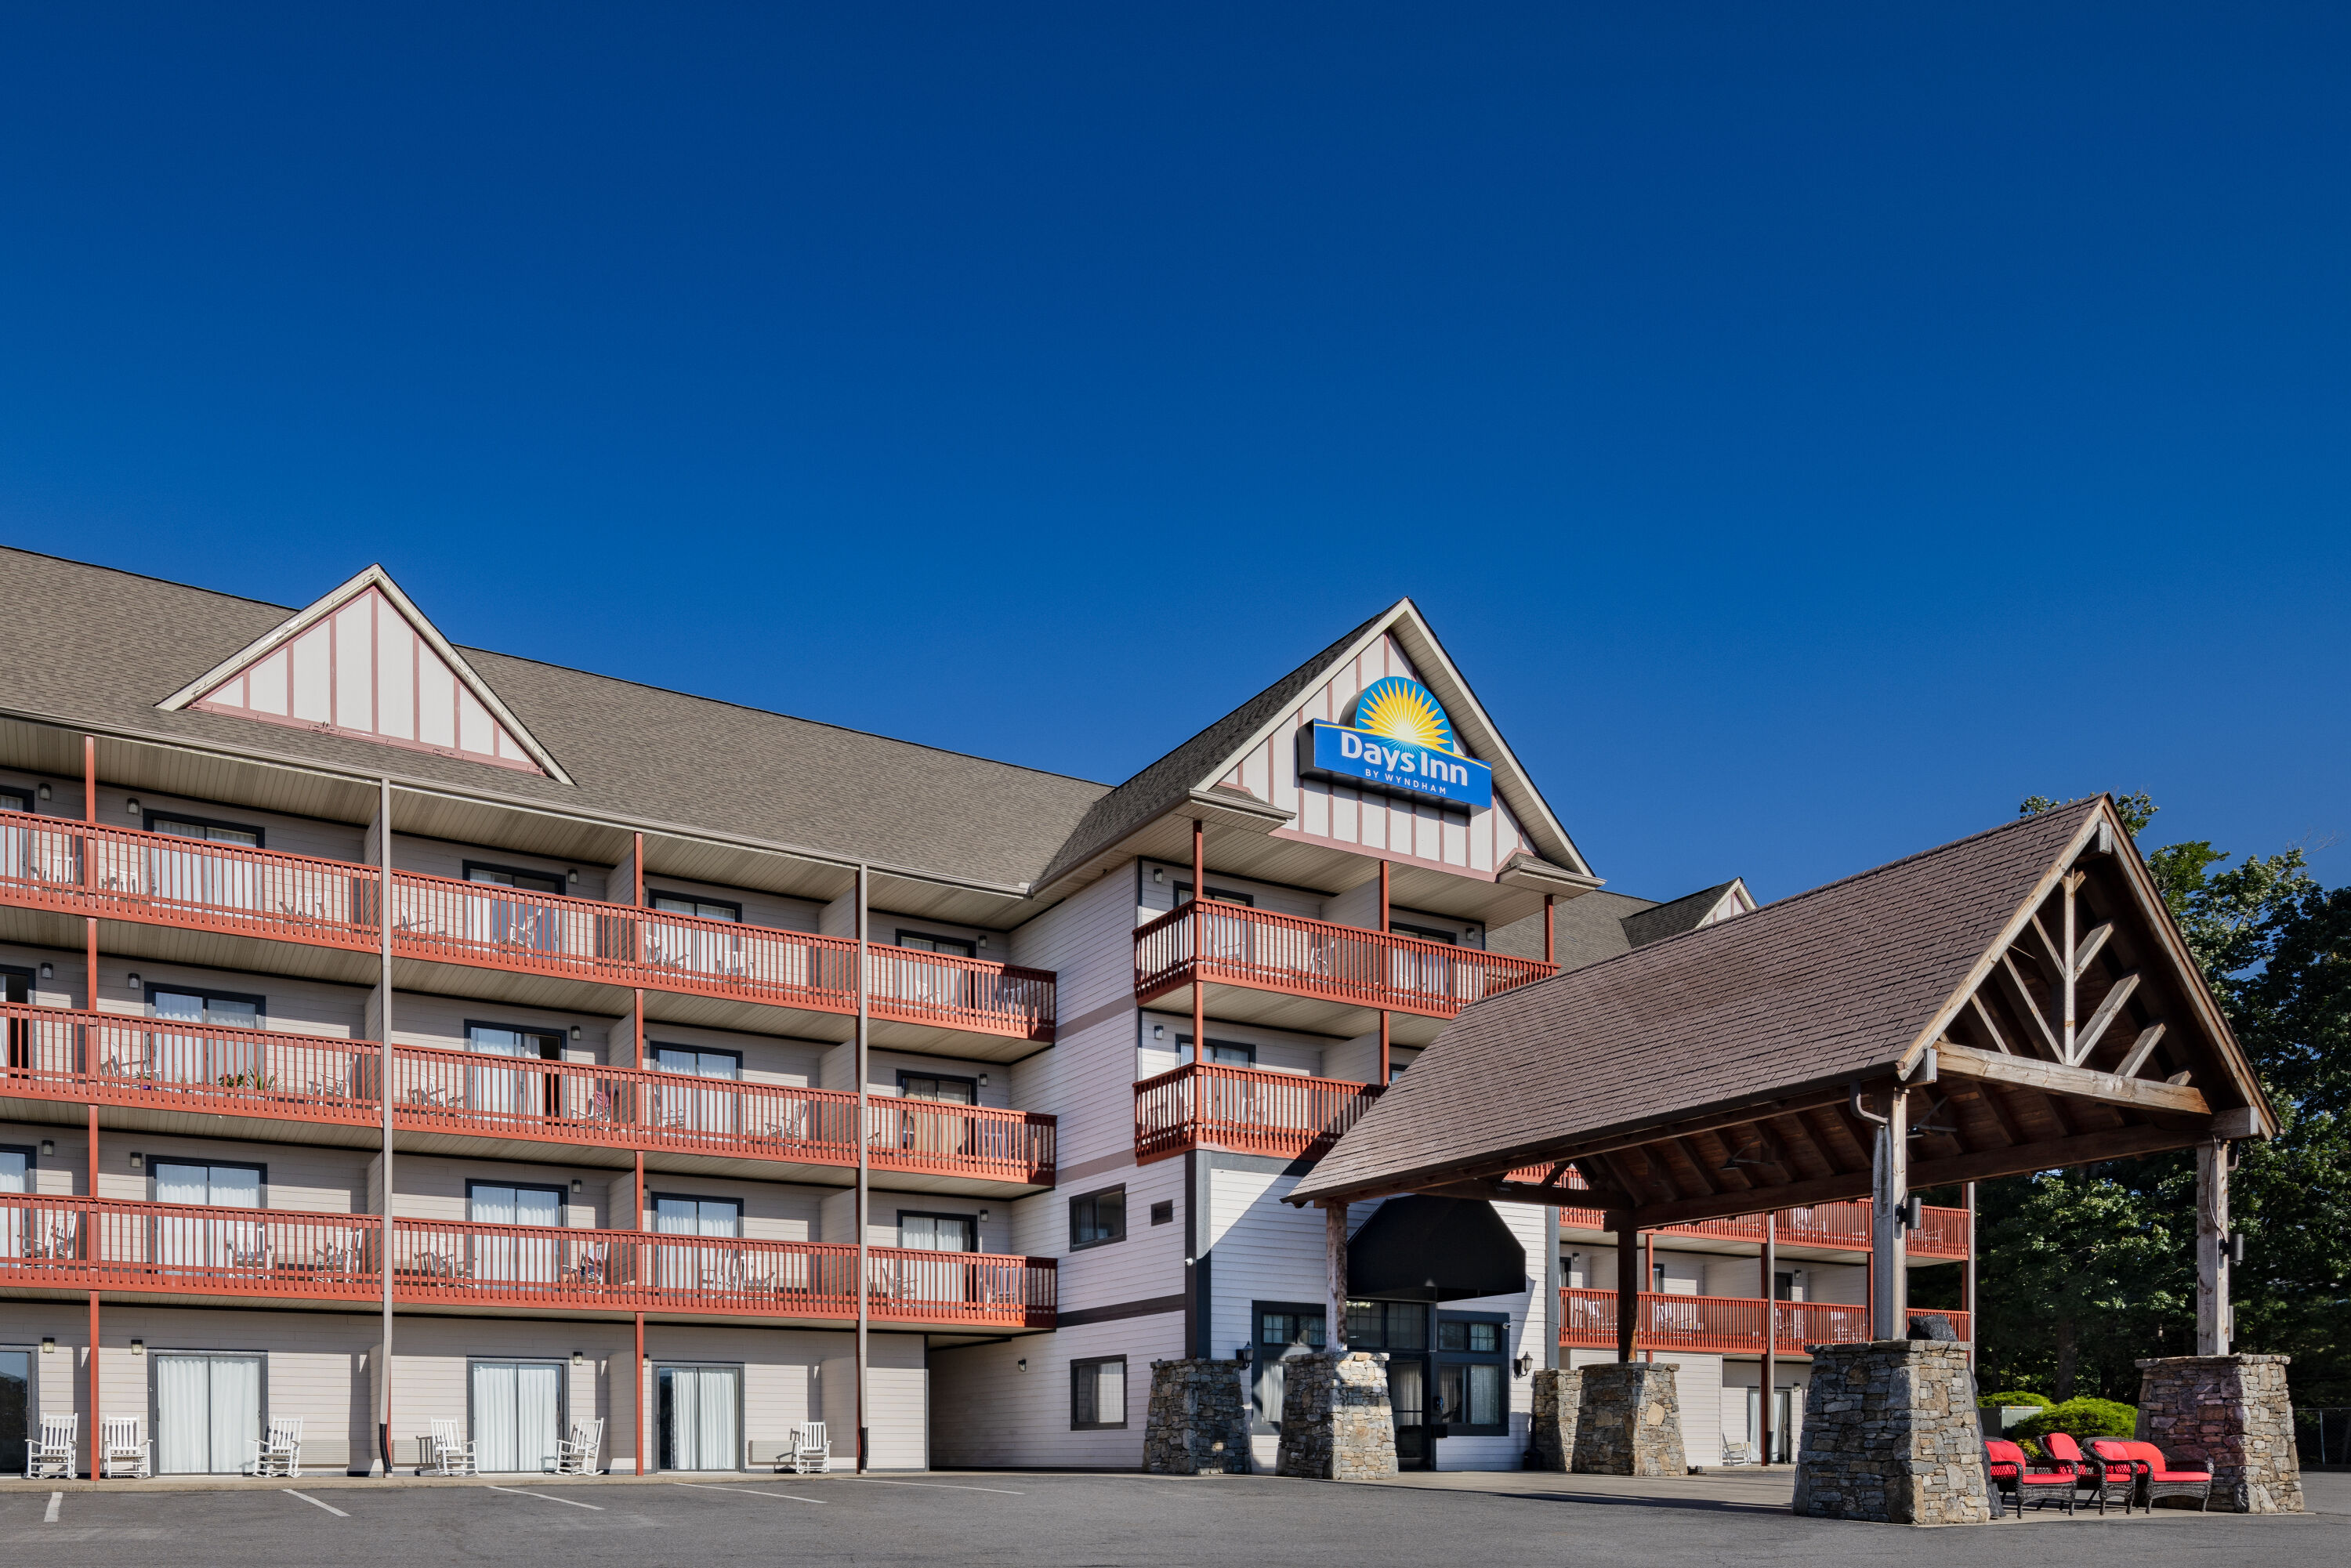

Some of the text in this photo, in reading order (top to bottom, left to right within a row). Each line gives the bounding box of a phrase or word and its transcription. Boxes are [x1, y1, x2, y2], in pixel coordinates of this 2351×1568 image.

[1341, 731, 1468, 787] Days Inn
[1365, 768, 1447, 795] BY WYNDHAM
